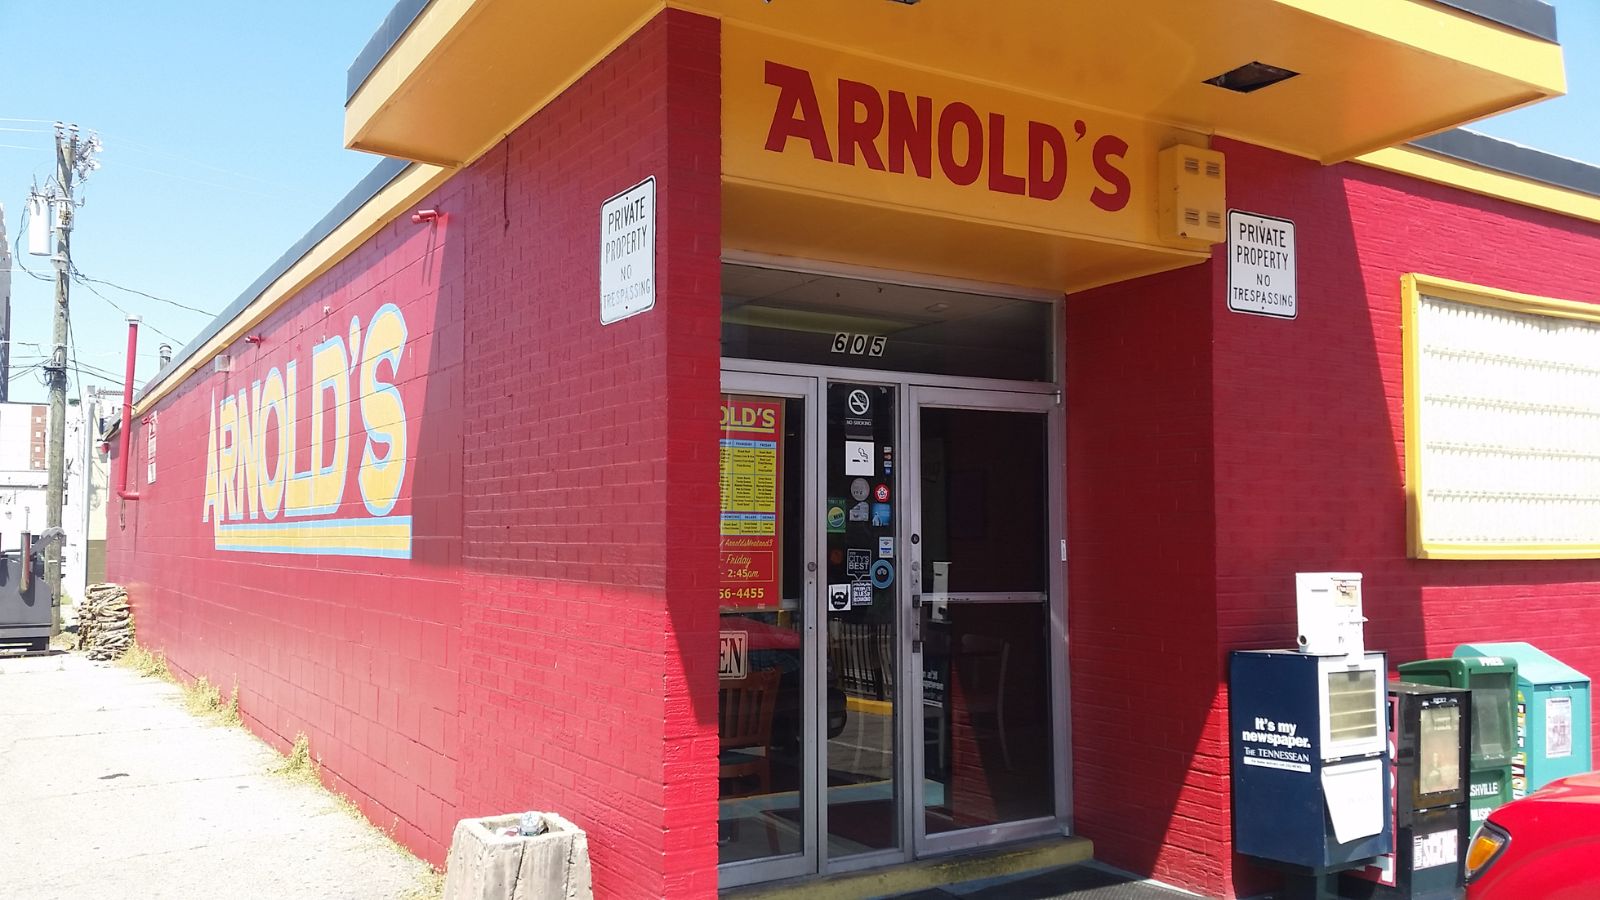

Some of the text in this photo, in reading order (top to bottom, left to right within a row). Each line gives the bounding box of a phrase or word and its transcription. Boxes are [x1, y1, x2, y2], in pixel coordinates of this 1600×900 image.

[764, 59, 1132, 212] ARNOLD'S
[608, 196, 646, 234] PRIVATE
[605, 225, 648, 264] PROPERTY
[1239, 222, 1287, 249] PRIVATE
[1236, 245, 1289, 271] PROPERTY
[620, 264, 632, 281] NO
[1256, 273, 1271, 287] NO
[603, 278, 650, 309] TRESPASSING
[1233, 287, 1293, 307] TRESPASSING
[834, 333, 883, 355] 605
[202, 303, 408, 524] ARNOLD'S
[726, 553, 751, 568] Friday
[848, 562, 869, 570] BEST
[1255, 716, 1297, 736] It's my
[1242, 730, 1312, 749] newspaper.
[1257, 748, 1310, 762] TENNESSEAN
